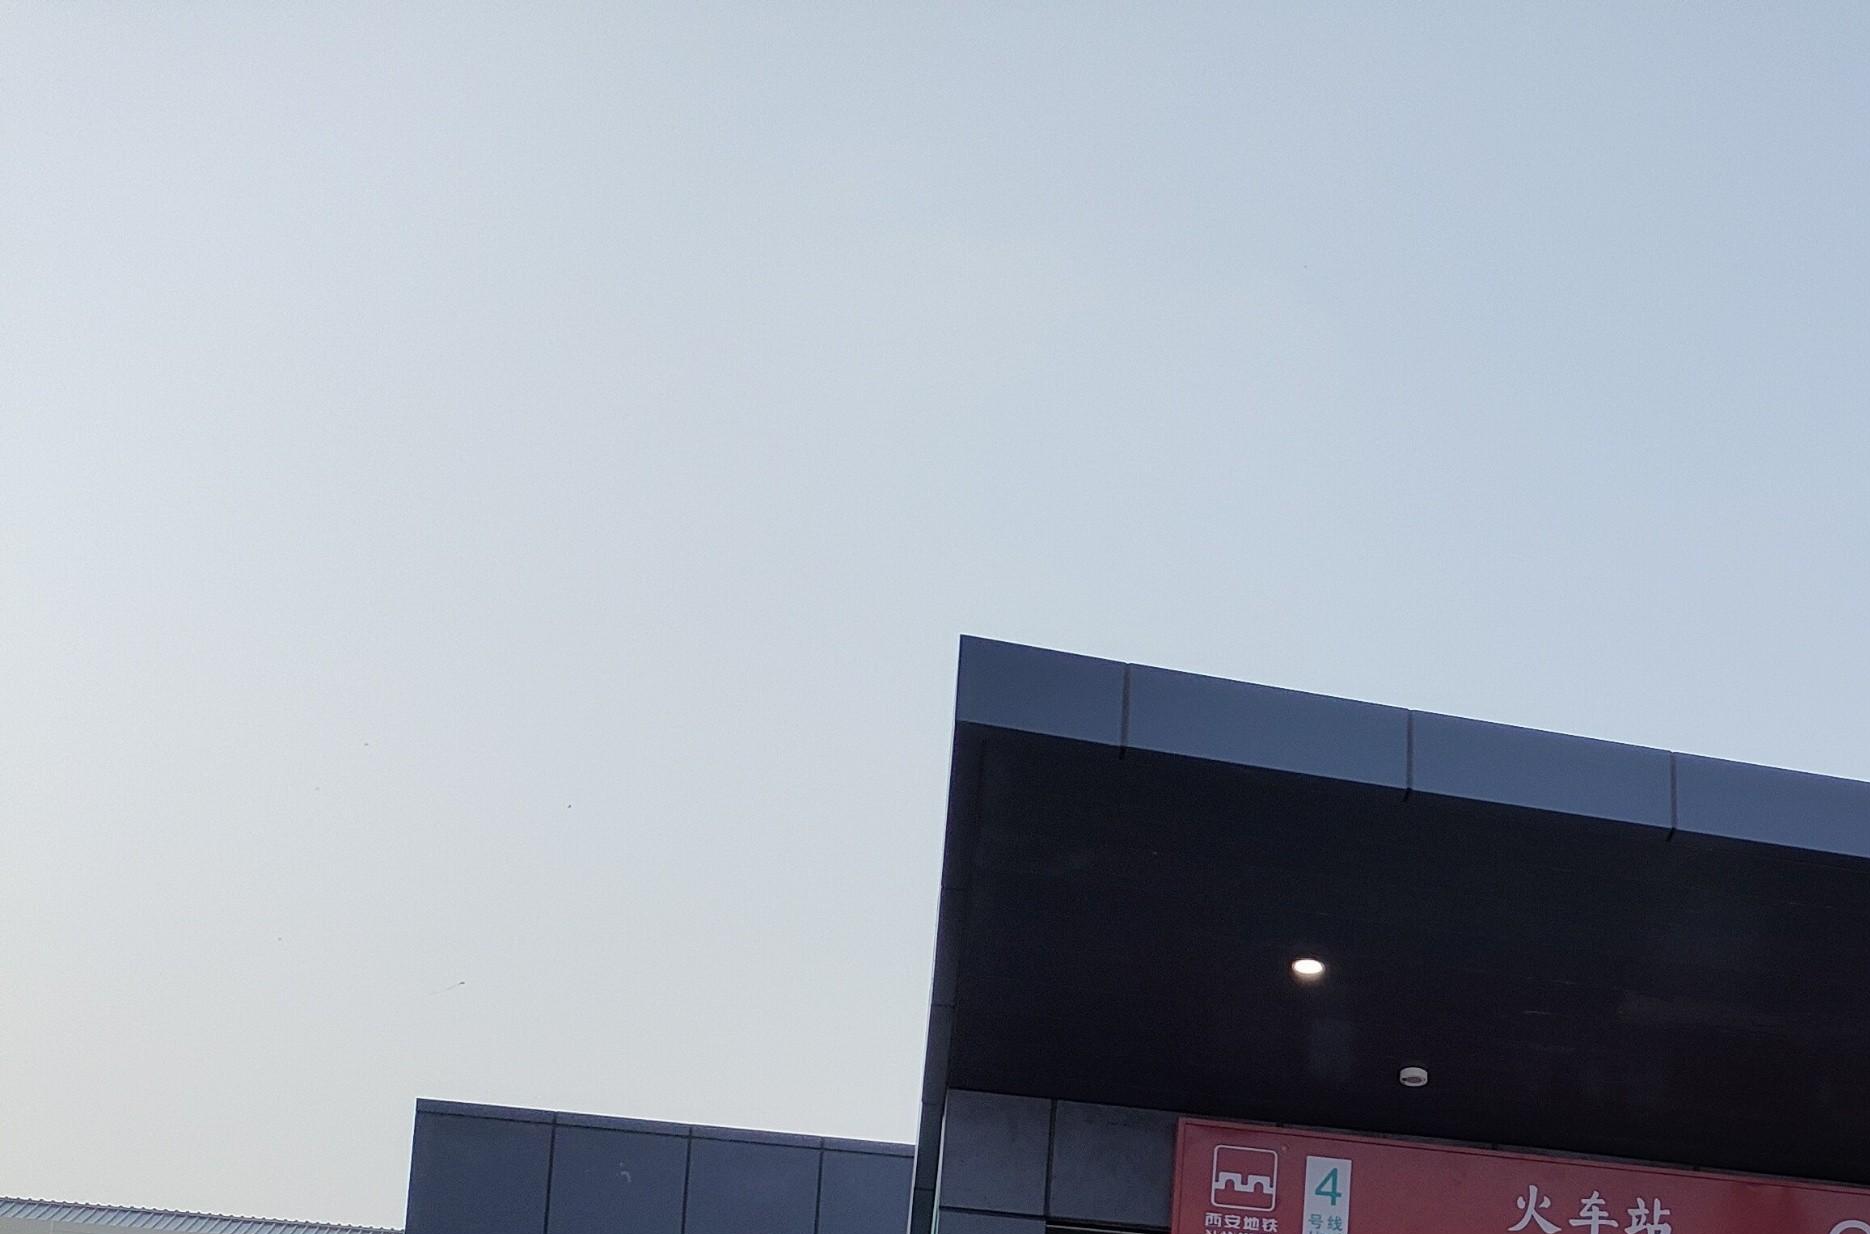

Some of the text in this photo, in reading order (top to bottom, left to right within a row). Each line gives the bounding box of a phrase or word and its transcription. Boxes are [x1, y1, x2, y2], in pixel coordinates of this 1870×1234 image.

[1314, 1167, 1342, 1206] 4
[1204, 1212, 1279, 1233] 西安地铁
[1308, 1213, 1343, 1232] 号线
